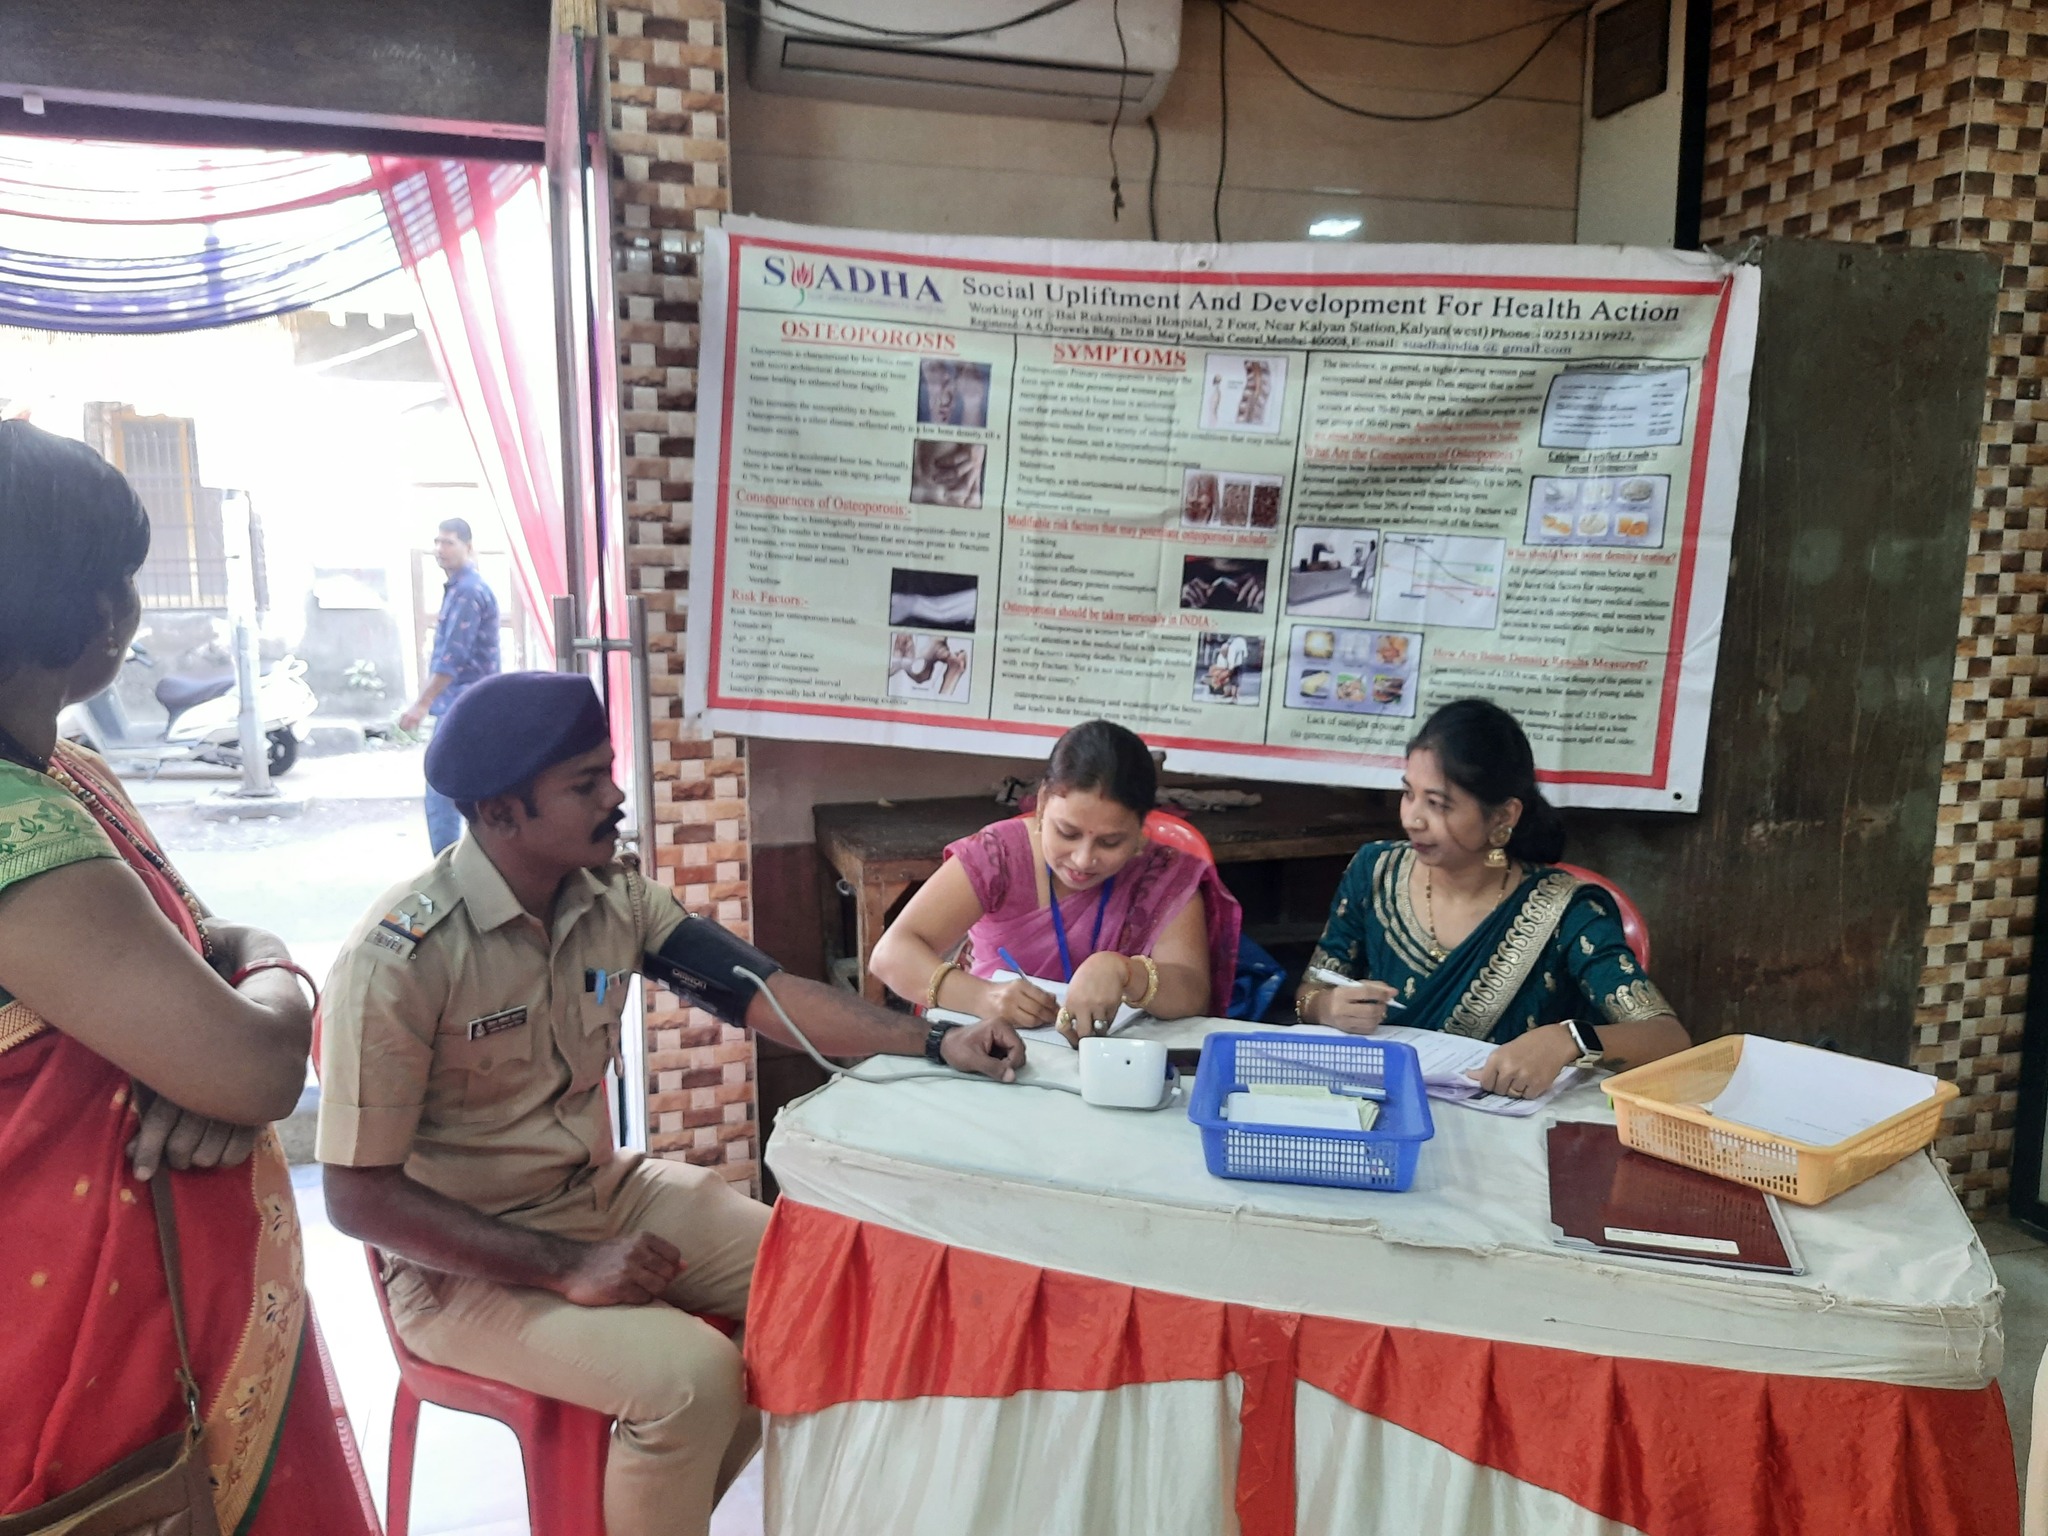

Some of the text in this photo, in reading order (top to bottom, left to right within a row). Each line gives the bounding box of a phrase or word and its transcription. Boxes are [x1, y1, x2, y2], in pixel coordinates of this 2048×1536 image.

[963, 276, 1680, 322] Social Upliftment And Development For Health Action
[969, 302, 1018, 319] Working
[1217, 317, 1224, 330] 2
[1264, 318, 1296, 332] Near
[1299, 319, 1346, 335] Kalyan
[781, 320, 956, 350] OSTEOPOROSIS
[1053, 343, 1187, 367] SYMPTOMS
[736, 489, 814, 507] Consequences
[818, 496, 832, 508] of
[732, 589, 756, 601] Risk
[1058, 606, 1087, 617] should
